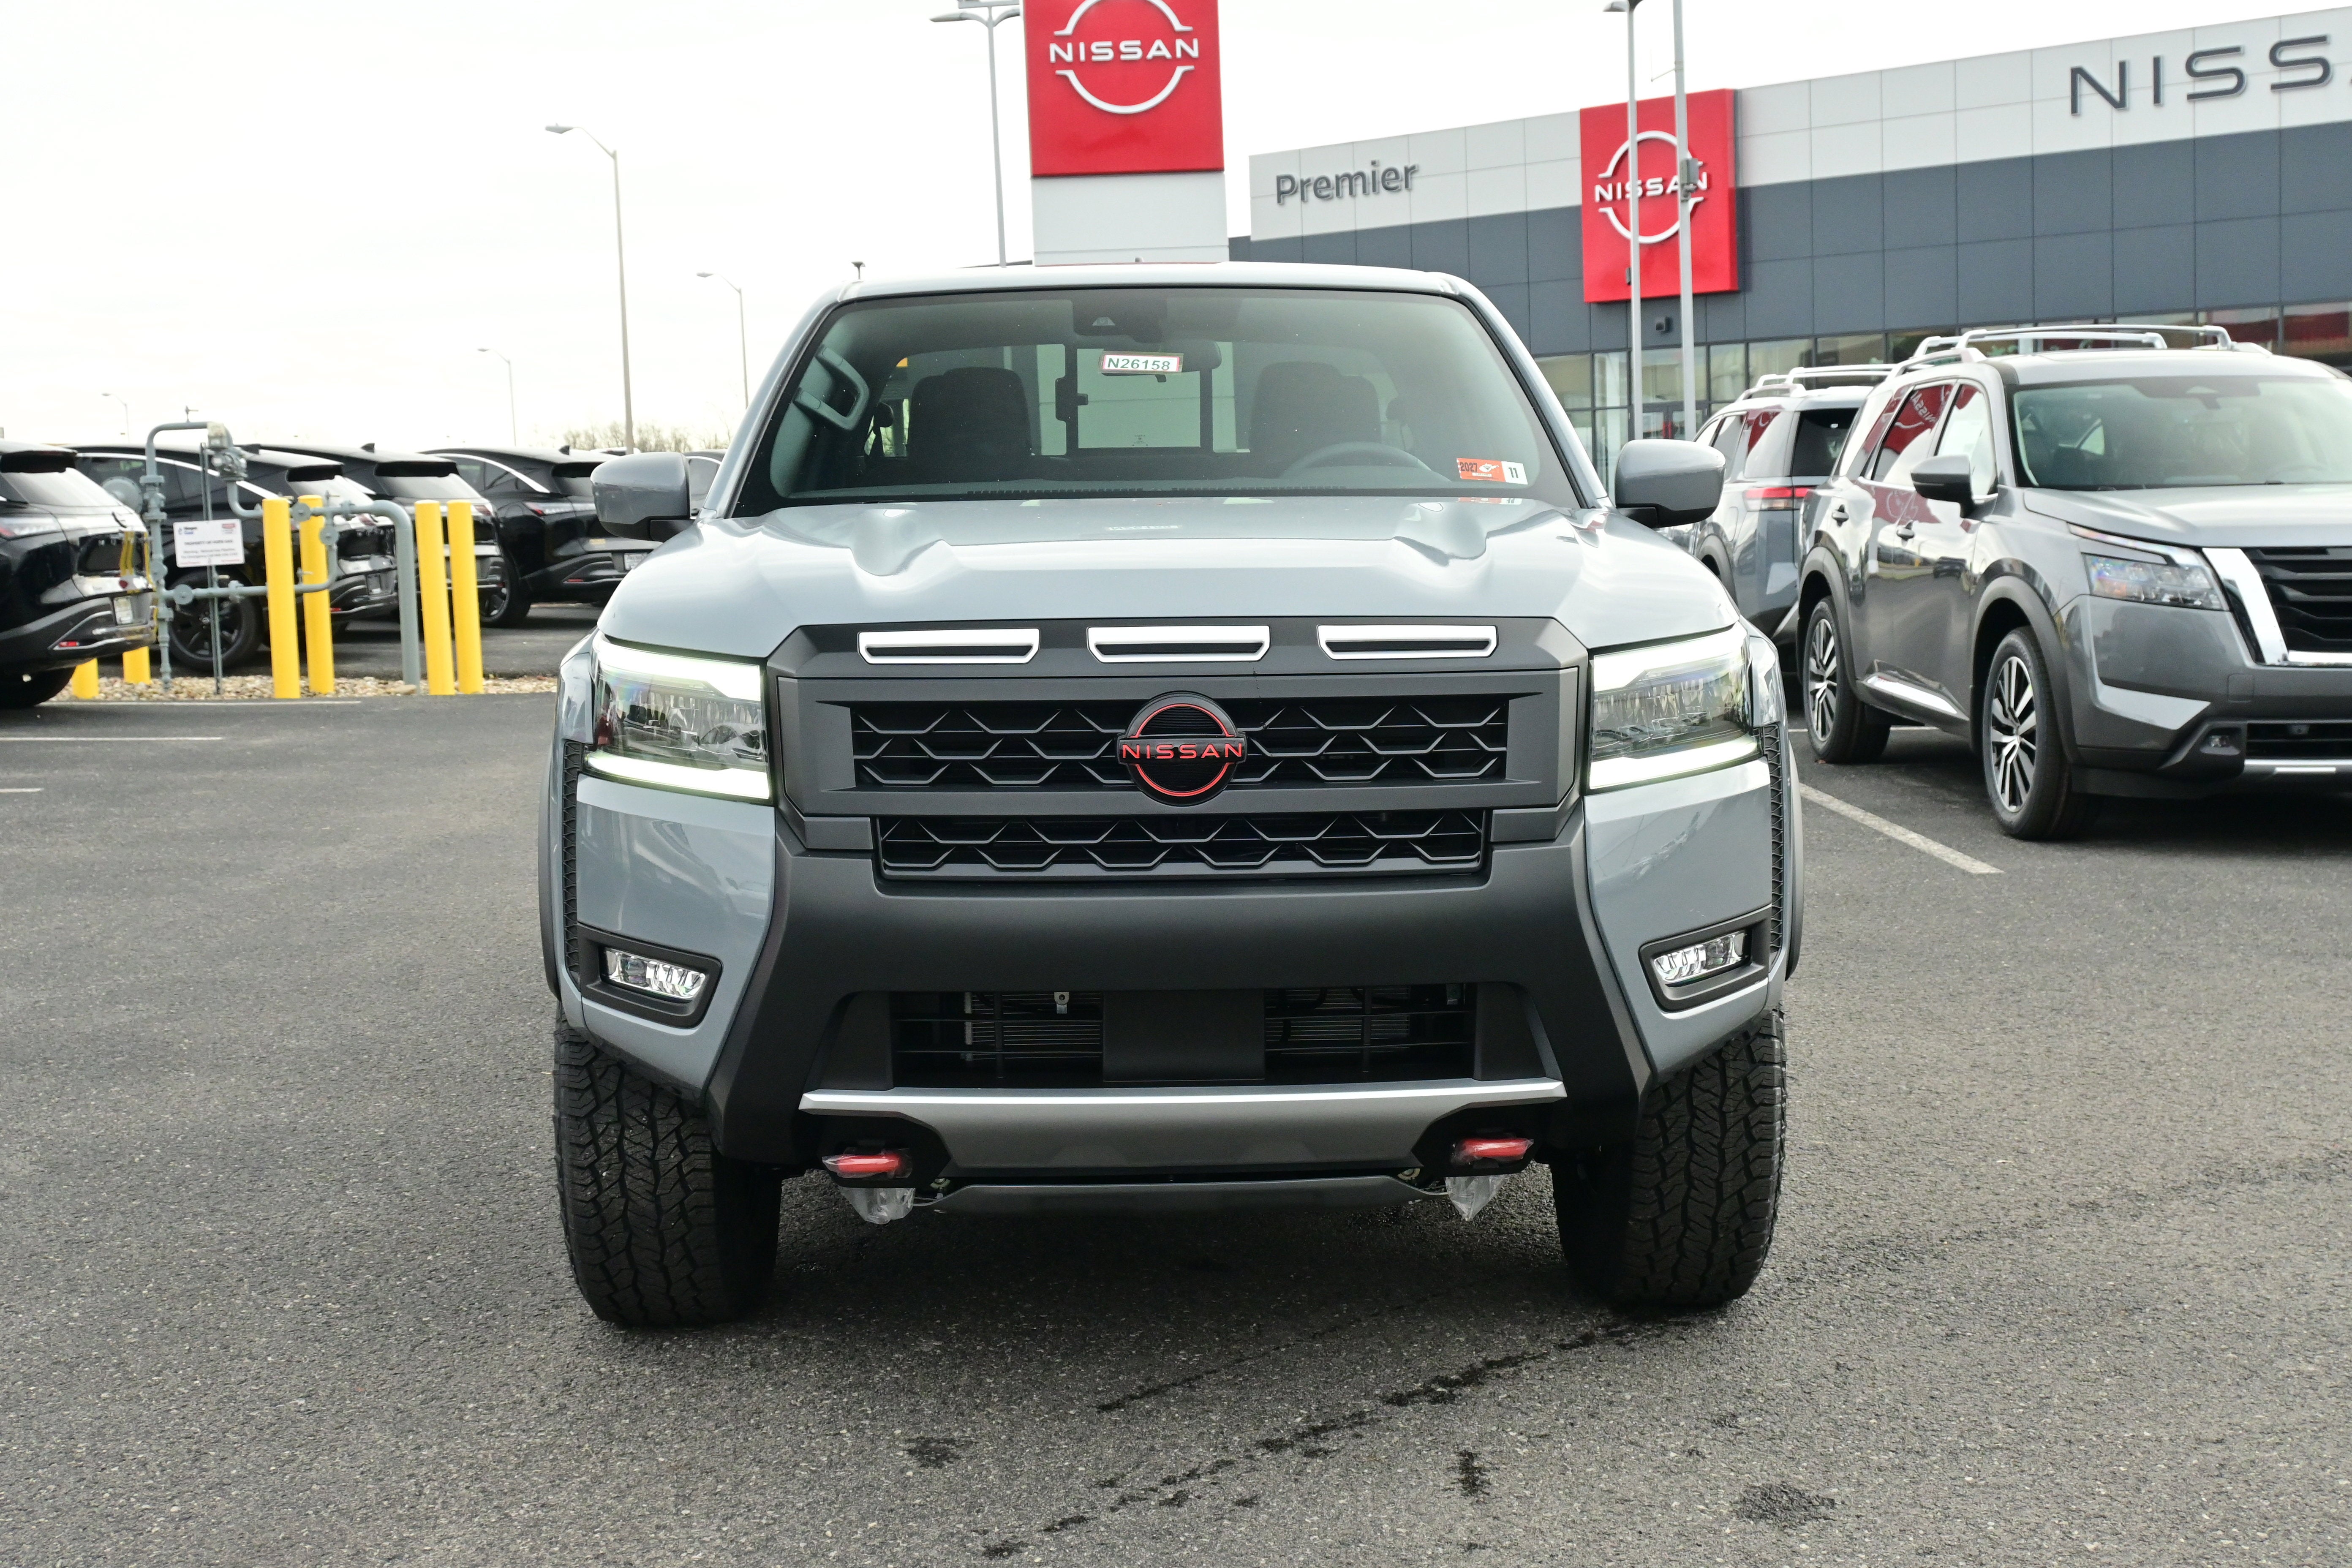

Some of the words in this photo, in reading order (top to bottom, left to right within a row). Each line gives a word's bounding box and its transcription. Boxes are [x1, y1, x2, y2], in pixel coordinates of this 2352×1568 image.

[1049, 38, 1199, 63] NISSAN
[2070, 35, 2352, 115] NISS
[1276, 160, 1418, 204] Premier
[1107, 357, 1170, 371] N26158
[1460, 461, 1478, 473] 2027
[1508, 467, 1519, 479] 11
[1122, 743, 1242, 759] NISSAN
